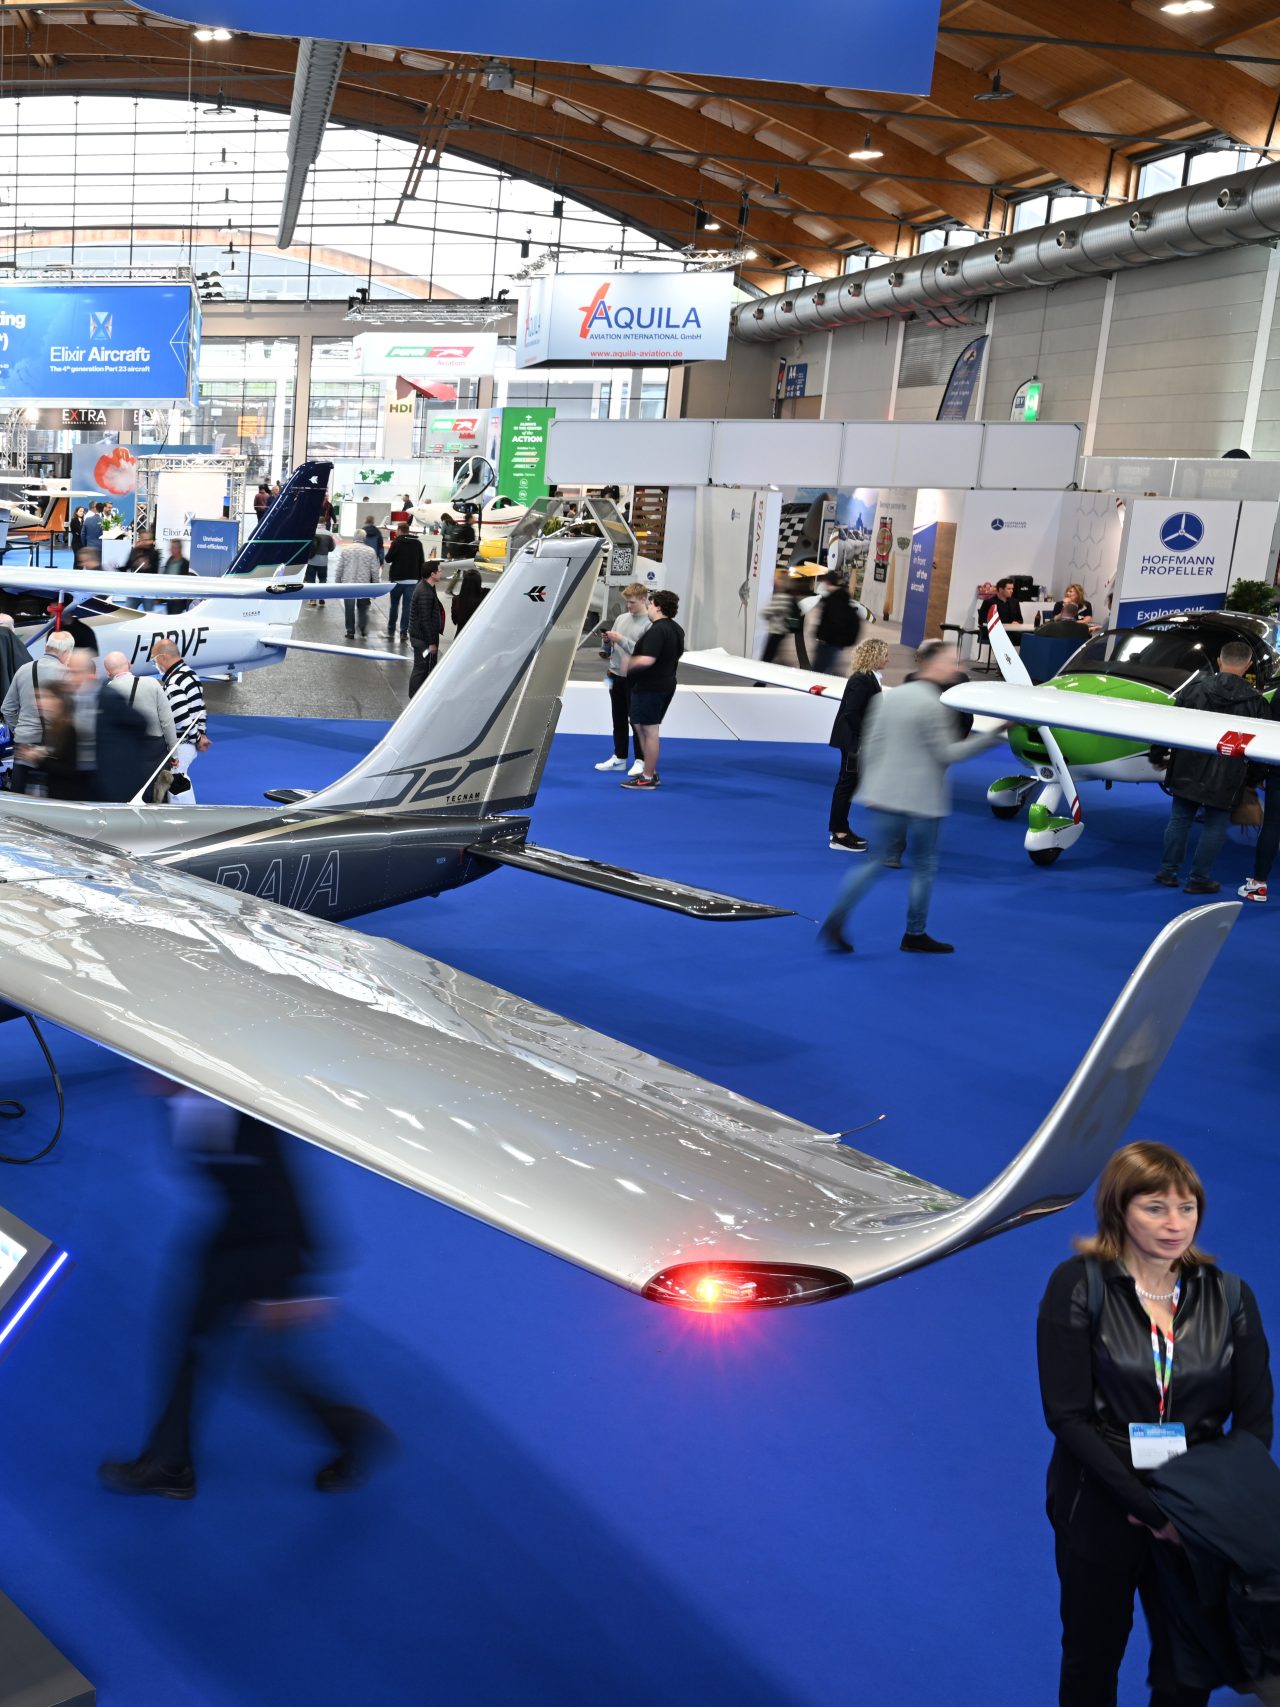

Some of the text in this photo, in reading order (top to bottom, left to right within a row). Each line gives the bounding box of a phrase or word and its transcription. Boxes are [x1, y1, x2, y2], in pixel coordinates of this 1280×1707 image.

[588, 300, 702, 330] AQUILA
[50, 346, 151, 362] Elixir Aircraft
[590, 350, 683, 359] www.aquila-aviation.de
[389, 404, 413, 413] HDI
[62, 409, 107, 422] EXTRA
[1142, 555, 1216, 566] HOFFMANN
[1140, 565, 1214, 576] PROPELLER
[446, 792, 481, 803] TECNAM
